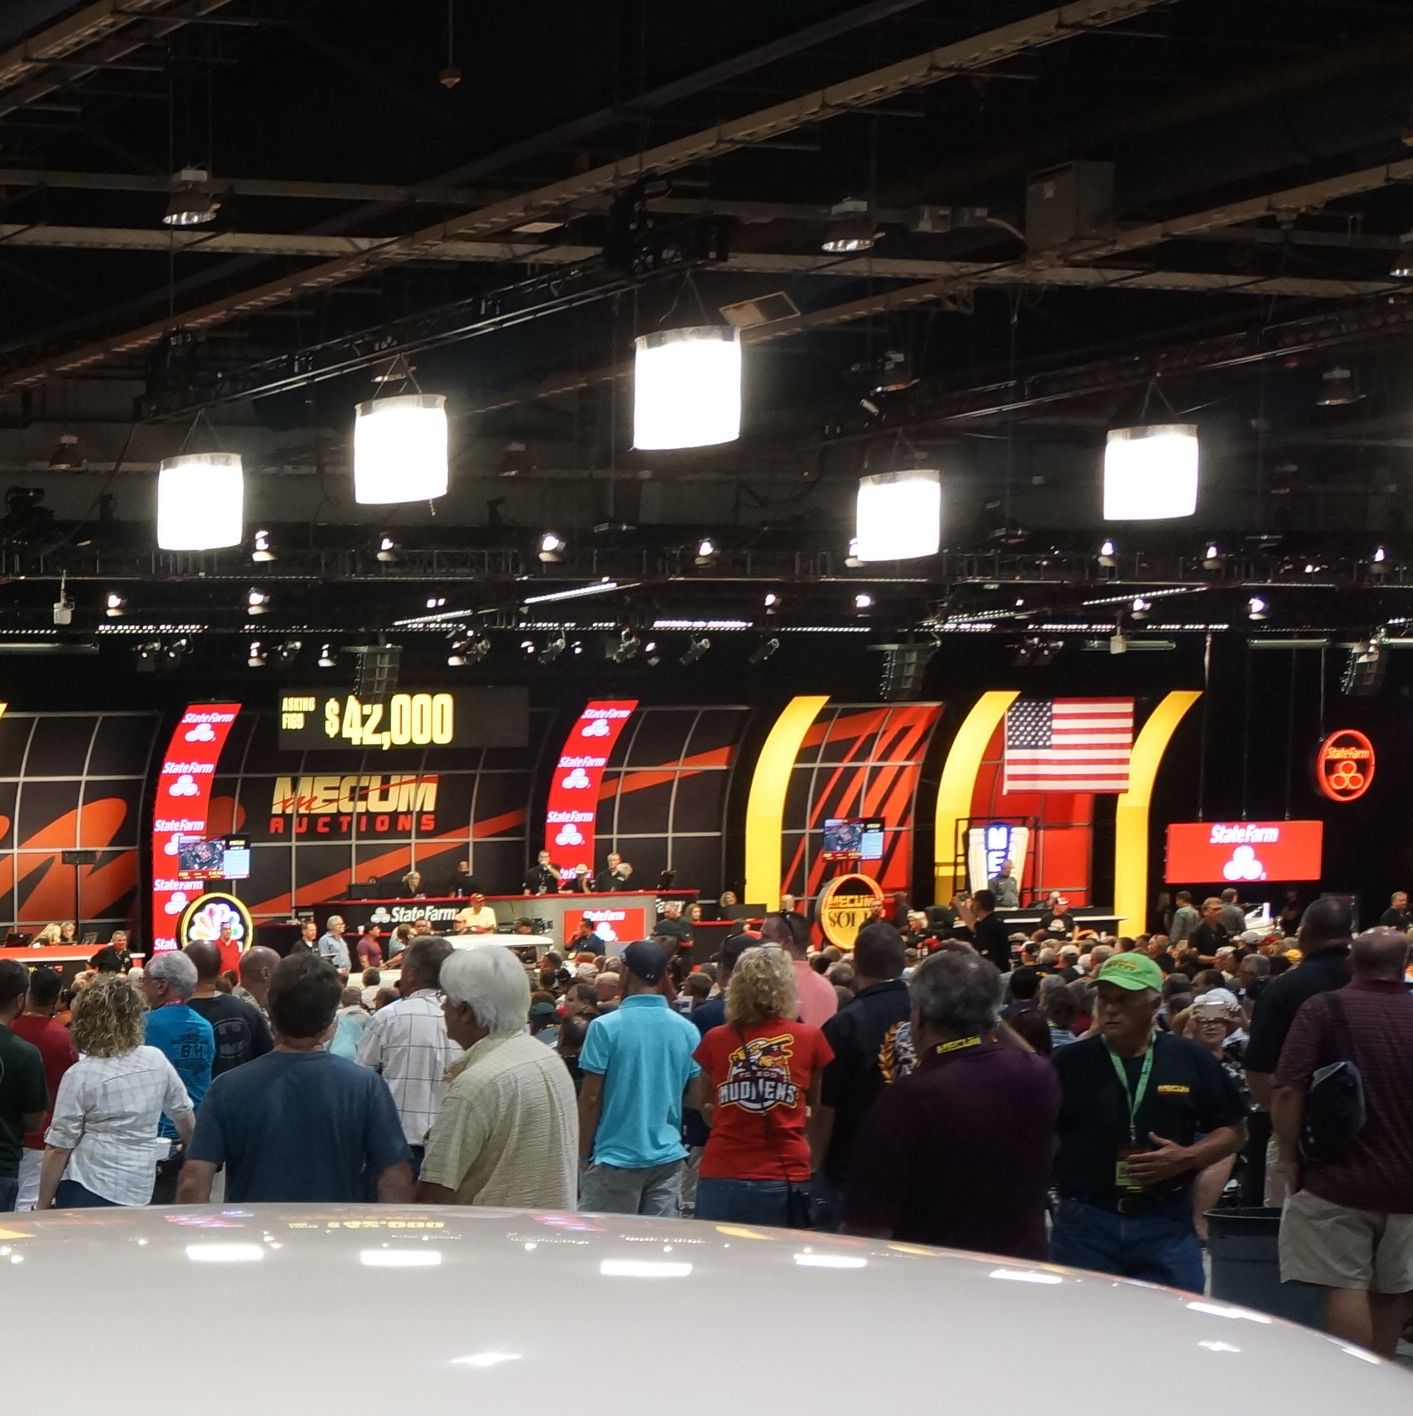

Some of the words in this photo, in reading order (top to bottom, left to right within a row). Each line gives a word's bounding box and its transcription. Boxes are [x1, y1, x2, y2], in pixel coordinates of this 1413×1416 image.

[282, 697, 316, 711] ASKING
[282, 713, 305, 729] F169
[325, 697, 340, 738] $
[342, 693, 454, 750] 42,000
[271, 775, 439, 814] MECUM
[269, 815, 435, 833] AUCTIONS
[828, 895, 872, 909] MECUM
[828, 911, 868, 928] SOL
[719, 1081, 750, 1104] MUD
